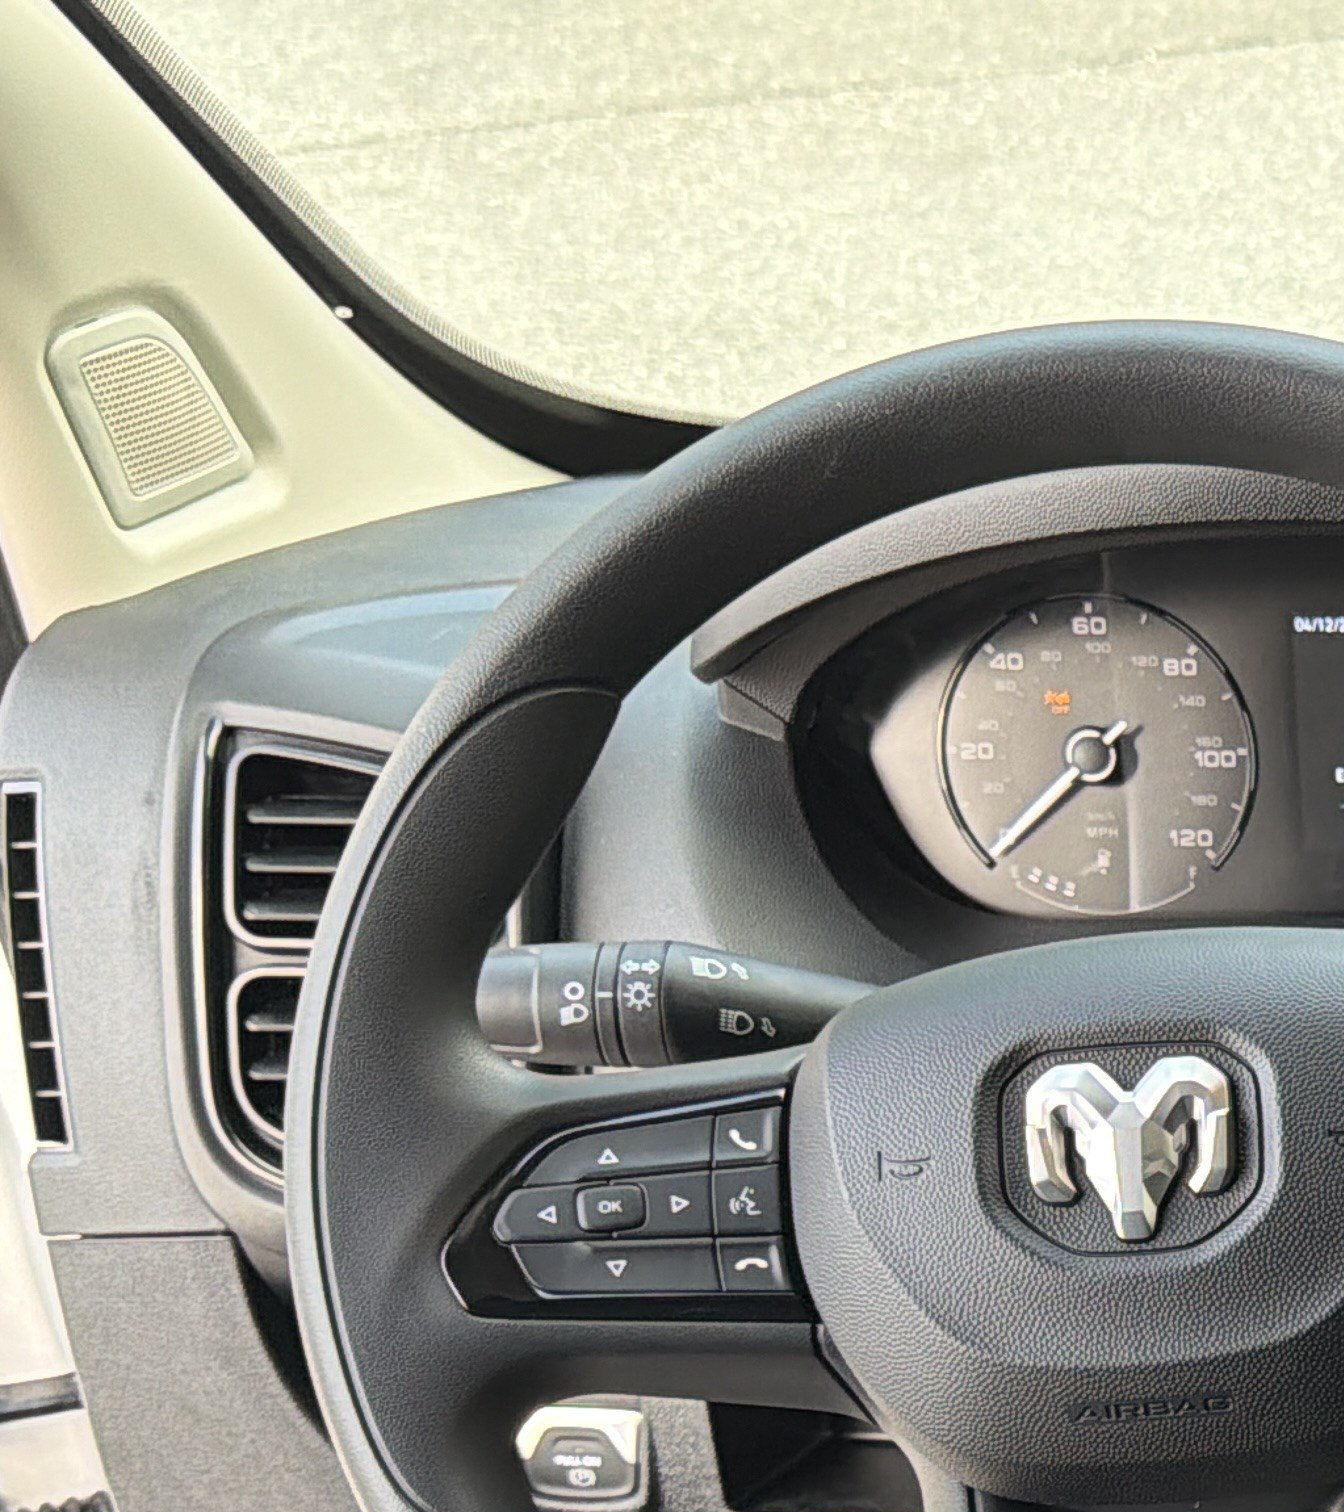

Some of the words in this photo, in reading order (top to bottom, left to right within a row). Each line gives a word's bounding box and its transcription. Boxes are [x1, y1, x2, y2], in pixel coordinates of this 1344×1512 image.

[1072, 616, 1107, 635] 60
[989, 652, 1024, 671] 40
[1163, 657, 1198, 676] 80
[960, 742, 994, 760] 20
[1194, 750, 1236, 768] 100
[1169, 829, 1213, 847] 120
[597, 1200, 623, 1214] OK
[1073, 1396, 1234, 1425] AIRBAG
